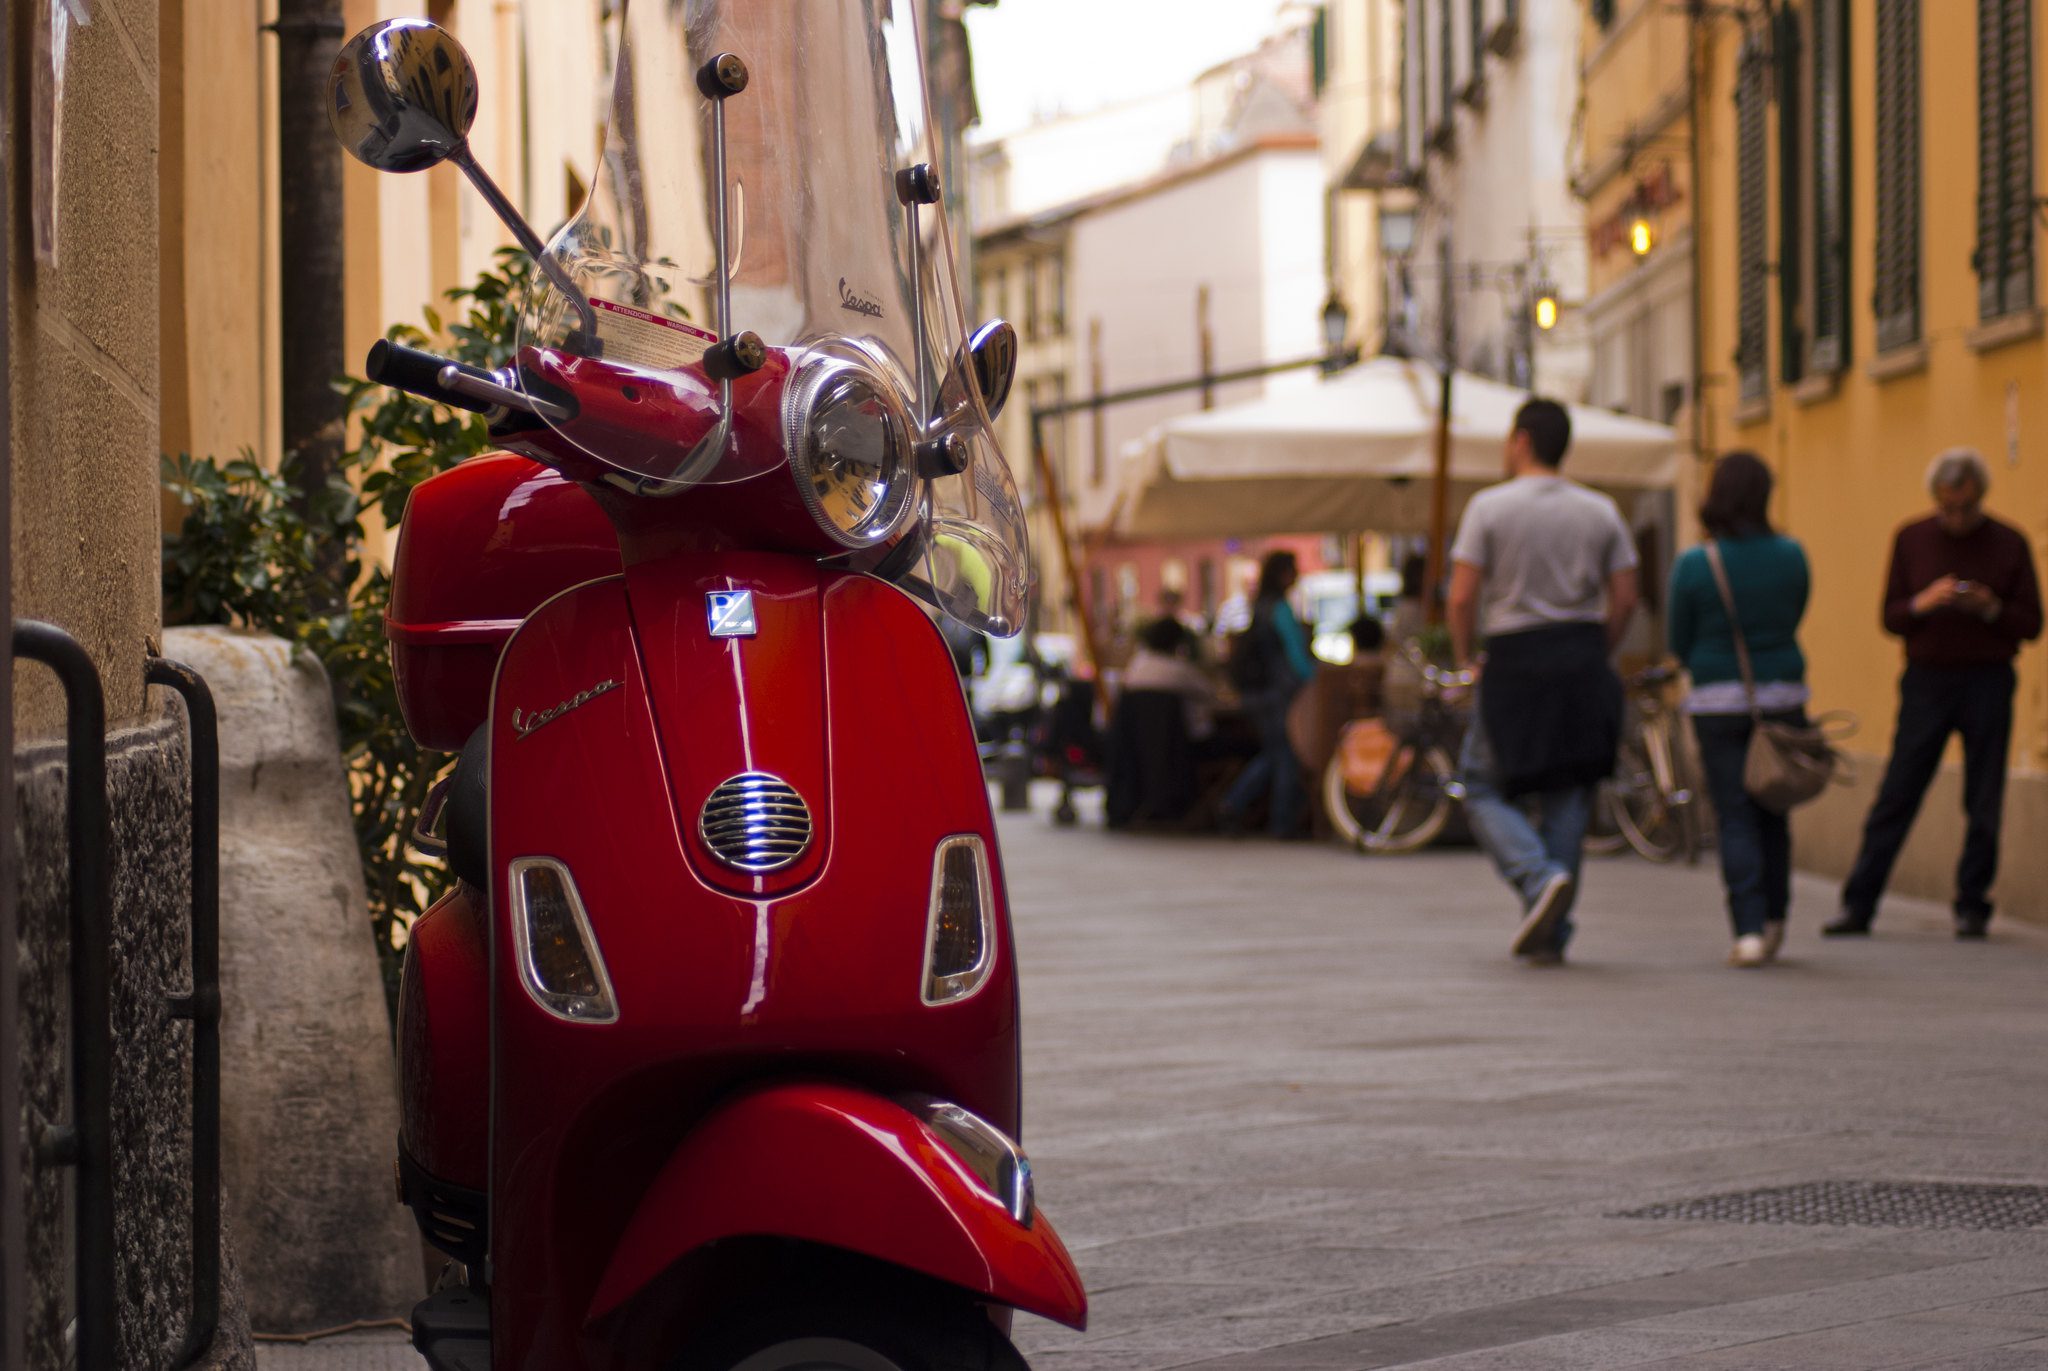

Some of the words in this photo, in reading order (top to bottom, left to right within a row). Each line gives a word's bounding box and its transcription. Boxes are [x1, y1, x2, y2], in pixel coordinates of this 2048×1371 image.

[838, 277, 884, 319] Vespa
[612, 305, 653, 322] ATTENZIONE!
[666, 320, 697, 336] WARNING!
[512, 678, 624, 741] Vespa
